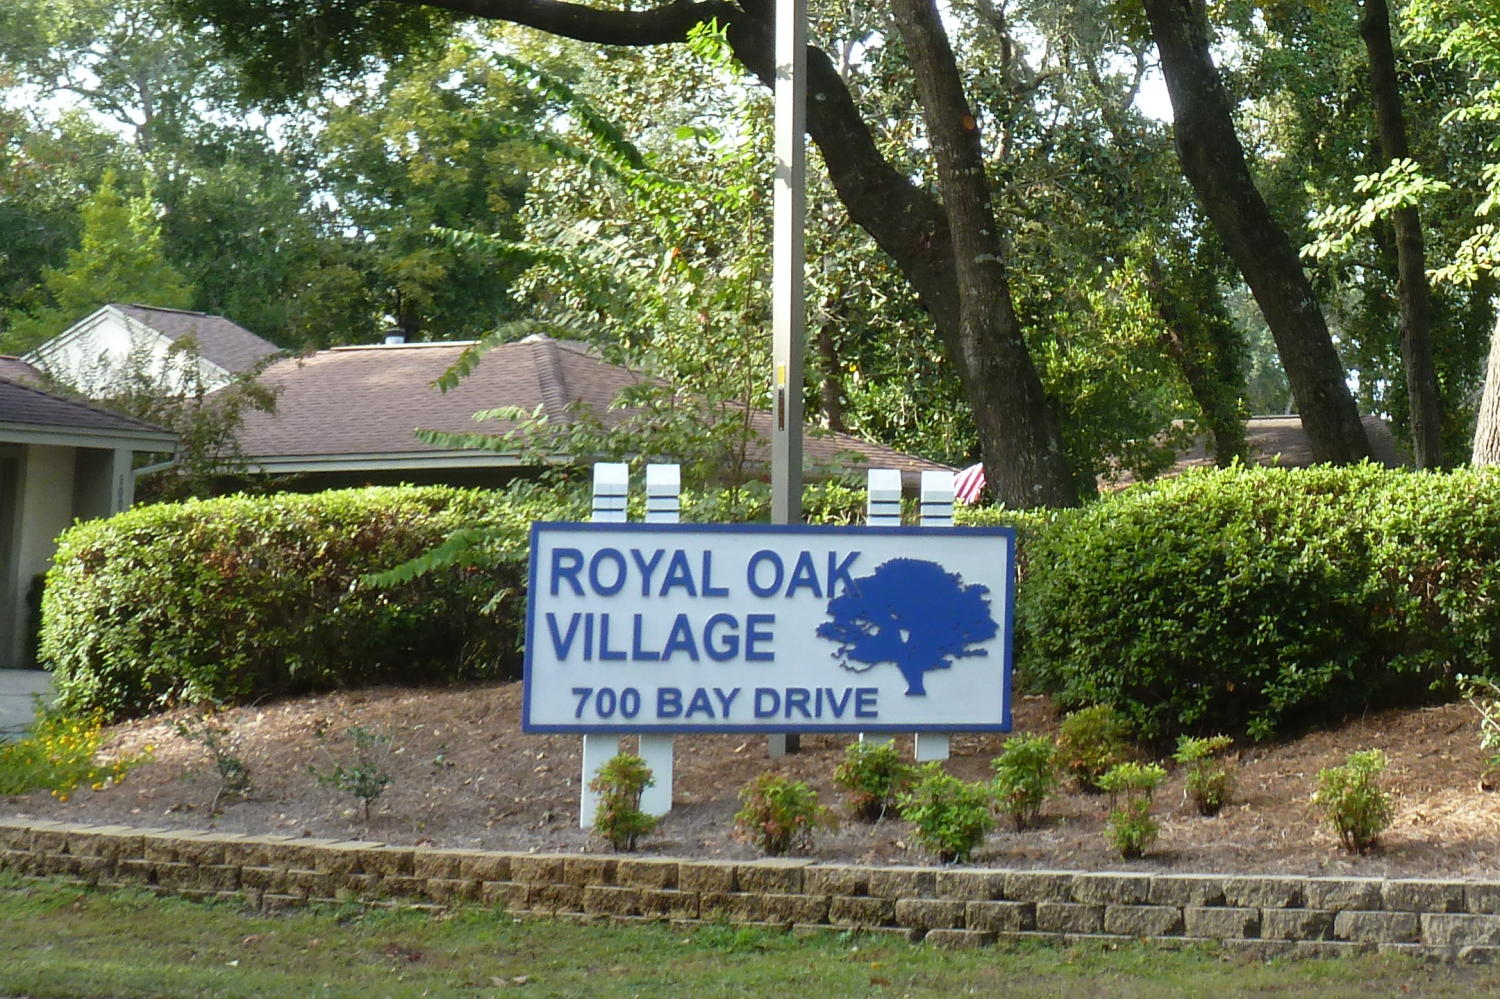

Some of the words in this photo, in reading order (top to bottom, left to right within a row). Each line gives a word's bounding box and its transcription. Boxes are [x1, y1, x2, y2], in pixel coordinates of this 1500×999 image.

[550, 547, 729, 598] ROYAL
[747, 550, 862, 599] OAK
[546, 612, 775, 662] VILLAGE
[572, 687, 641, 719] 700
[656, 687, 741, 719] BAY
[754, 687, 879, 719] DRIVE
